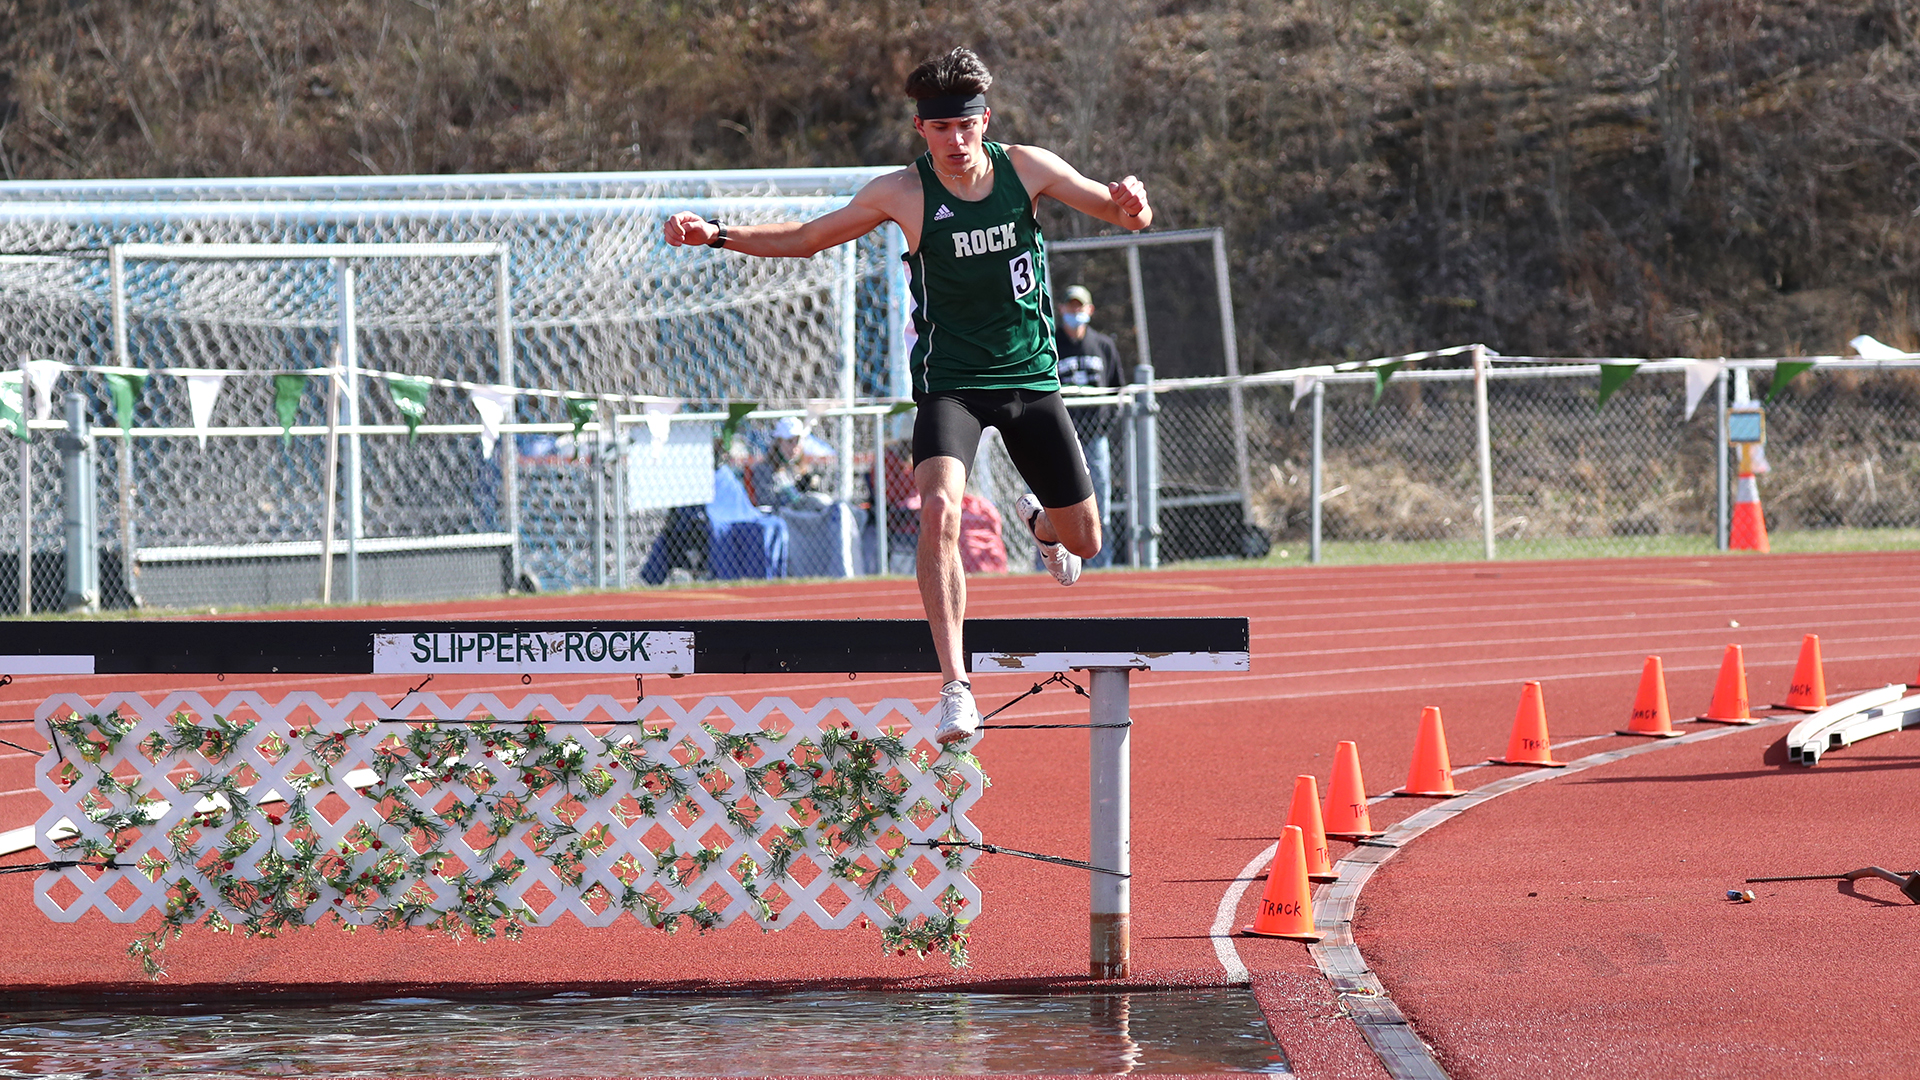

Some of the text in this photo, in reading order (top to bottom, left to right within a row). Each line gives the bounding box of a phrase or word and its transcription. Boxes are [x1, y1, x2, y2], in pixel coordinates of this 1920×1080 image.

[934, 211, 955, 221] adidas
[952, 222, 1017, 258] ROCK
[1013, 257, 1032, 294] 3
[411, 632, 650, 663] SLIPPERY ROCK
[1263, 898, 1302, 917] TRACK
